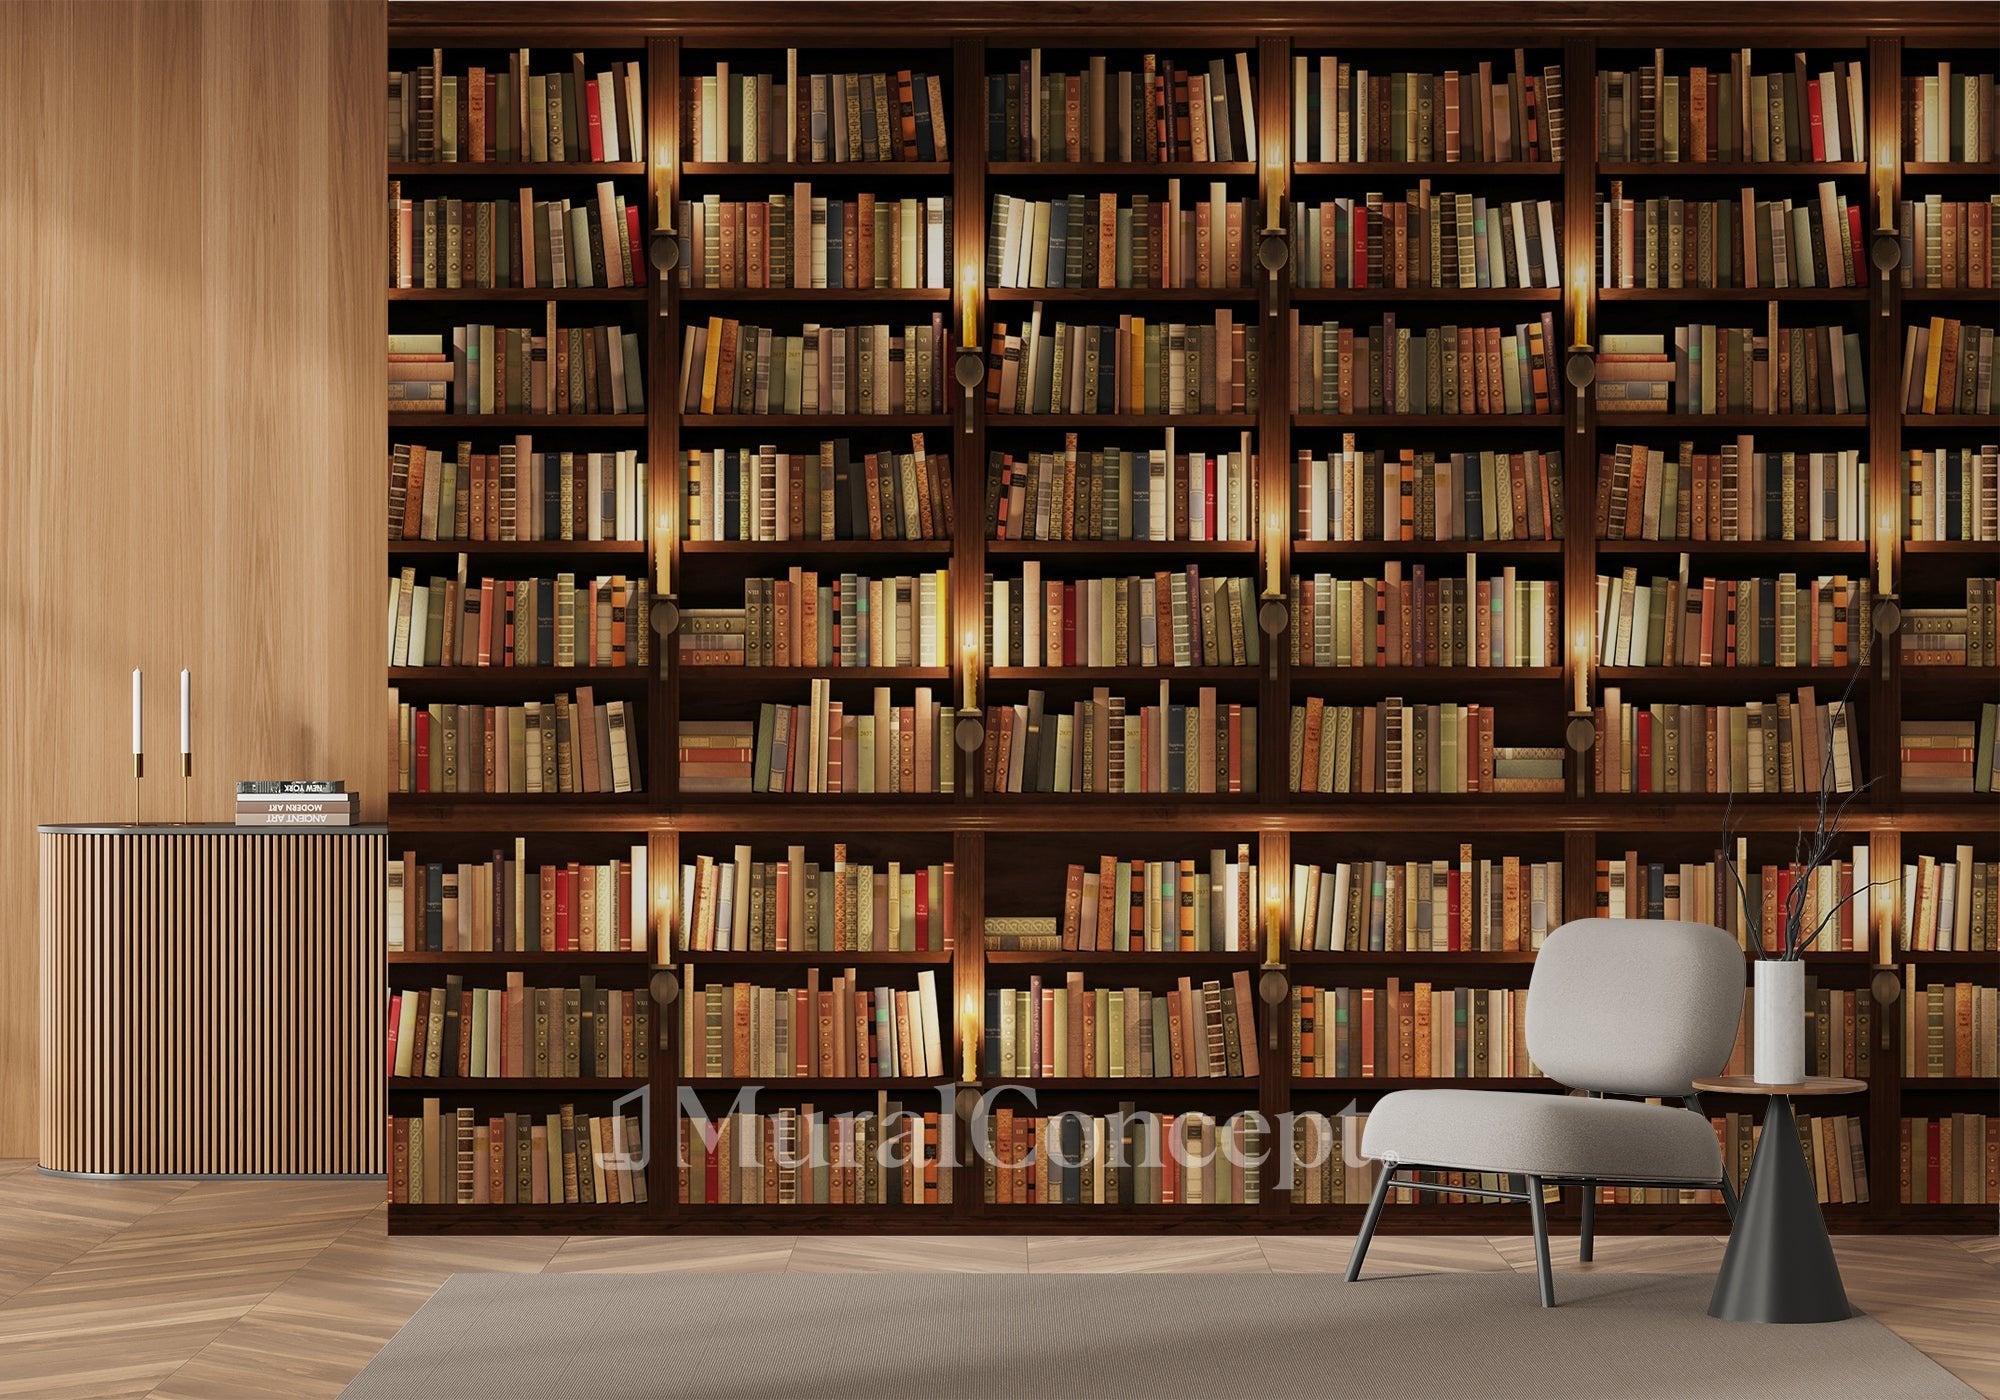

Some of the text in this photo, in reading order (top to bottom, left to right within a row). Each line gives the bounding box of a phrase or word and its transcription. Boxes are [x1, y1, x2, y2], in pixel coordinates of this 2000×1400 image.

[284, 784, 323, 792] NEW YORK
[266, 814, 327, 823] ANCIENT ART
